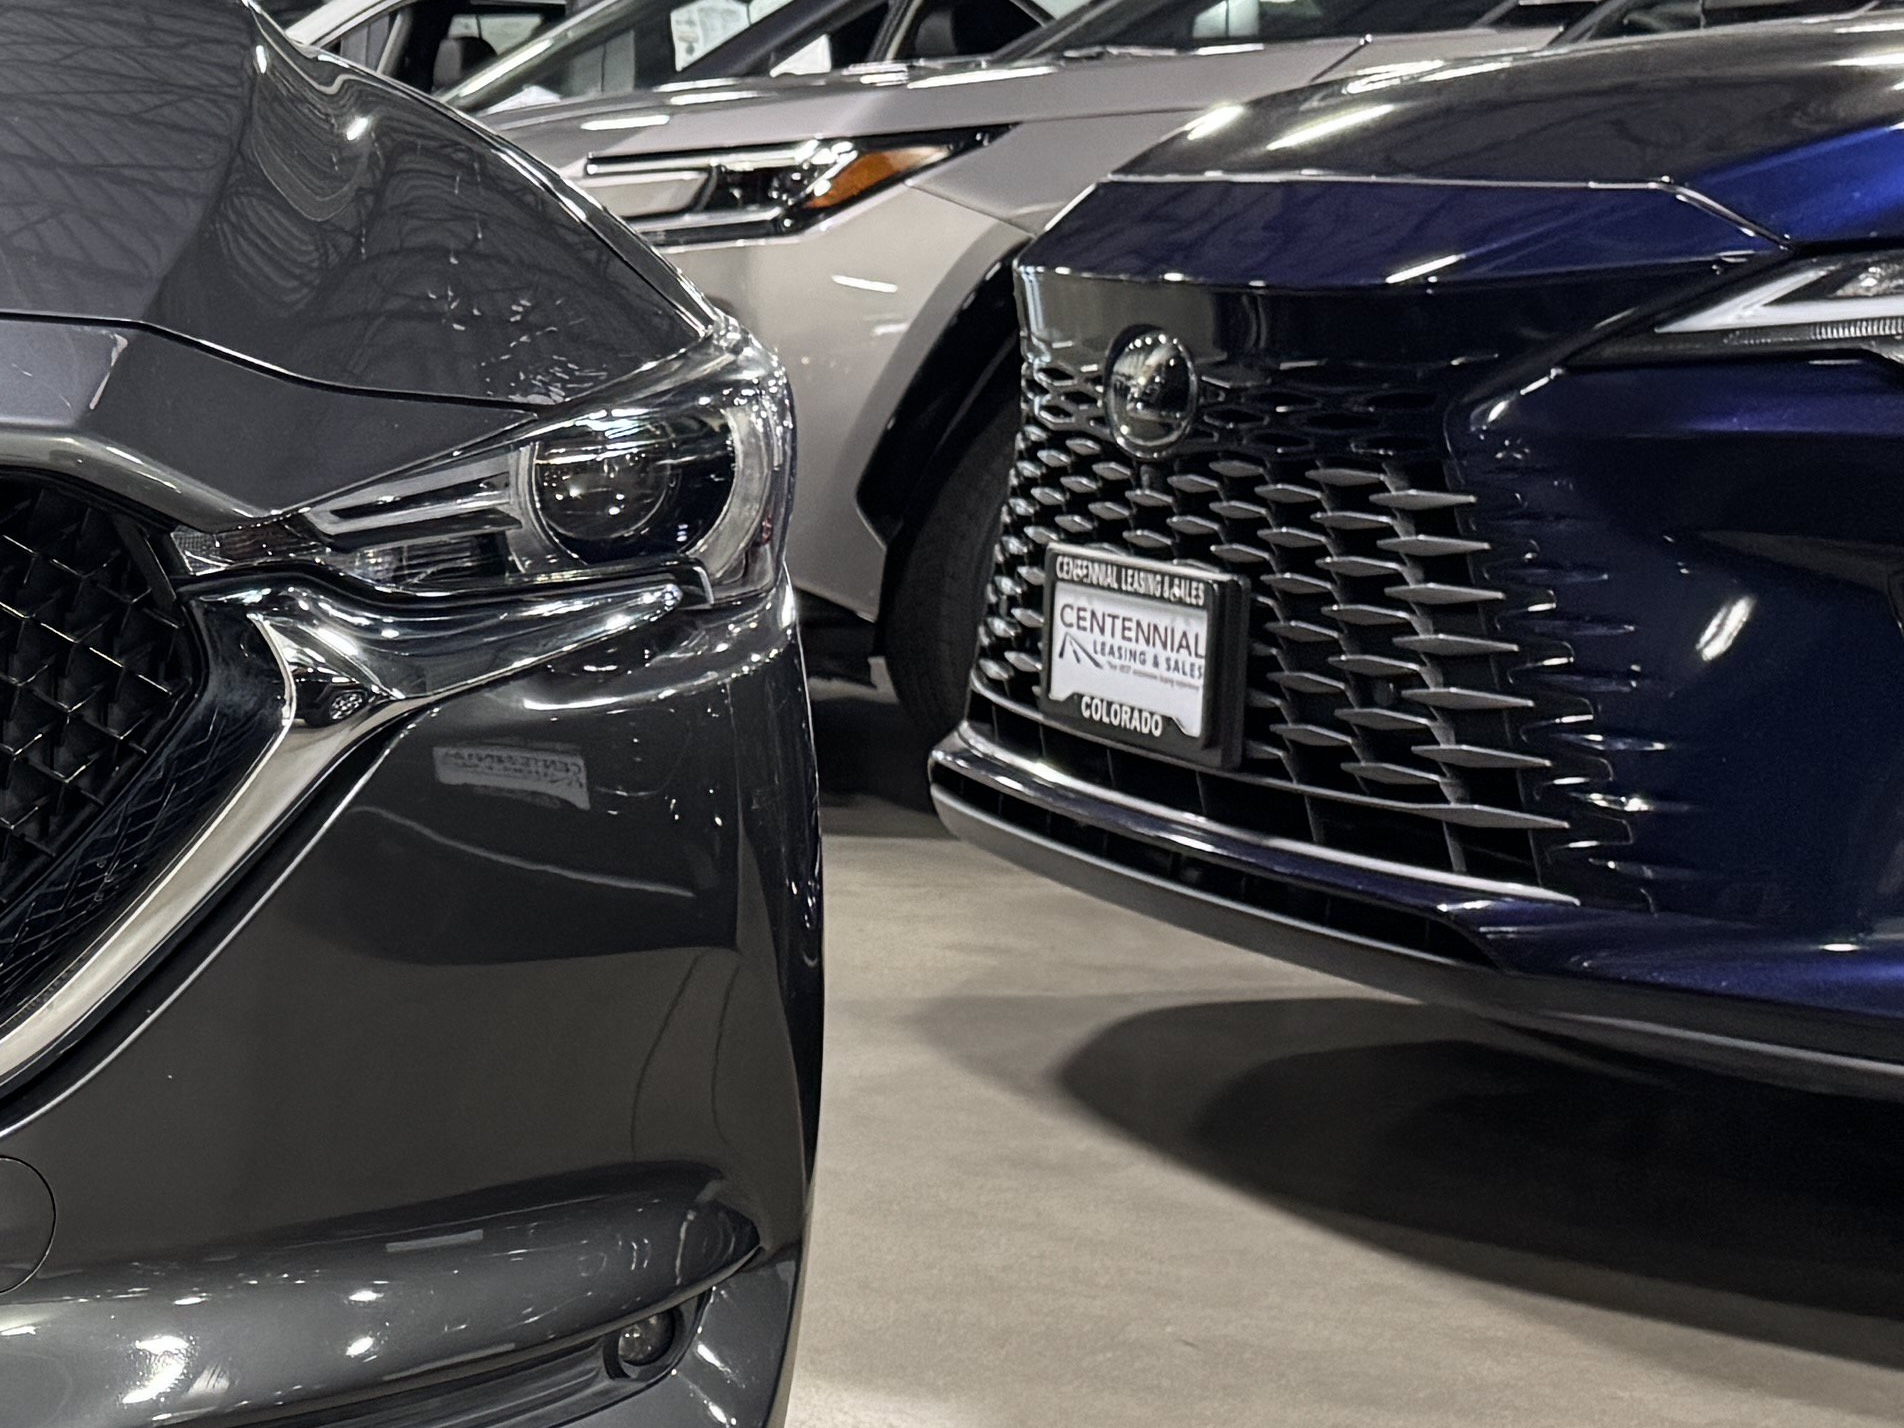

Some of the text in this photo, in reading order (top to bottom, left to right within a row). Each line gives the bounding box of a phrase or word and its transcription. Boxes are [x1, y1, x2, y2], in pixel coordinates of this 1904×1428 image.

[1060, 604, 1205, 659] CENTENNIAL
[1093, 640, 1147, 666] LEASING
[1153, 654, 1160, 669] &
[1165, 657, 1203, 680] SALES
[1081, 696, 1163, 737] COLORADO
